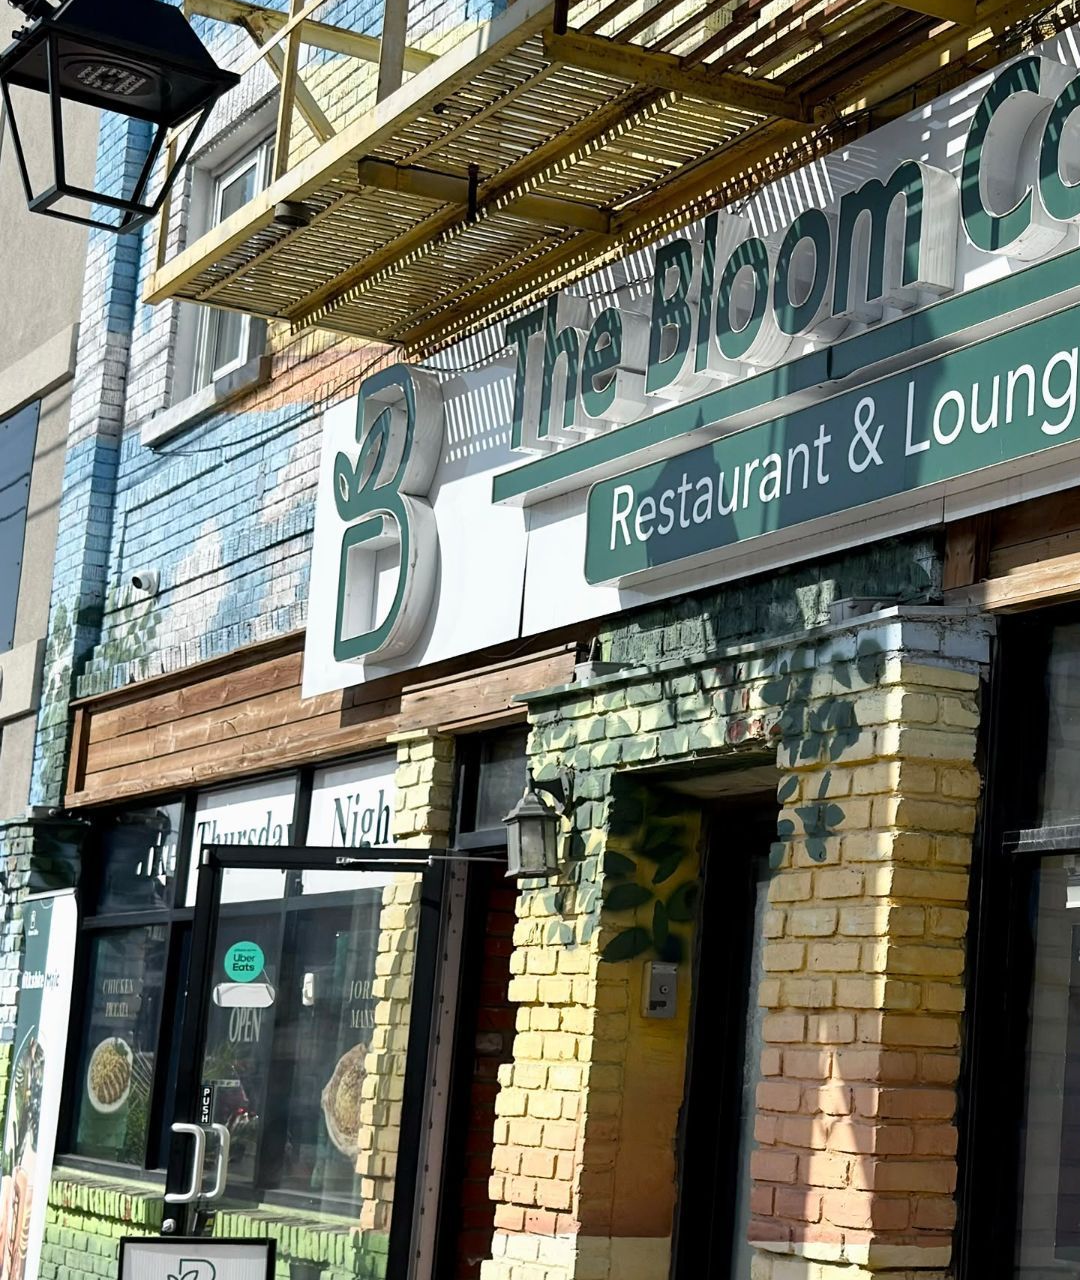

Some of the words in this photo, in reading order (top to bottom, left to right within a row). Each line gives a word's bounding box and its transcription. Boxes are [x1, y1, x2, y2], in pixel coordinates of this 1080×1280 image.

[504, 293, 623, 450] The
[643, 158, 927, 403] Bloom
[609, 427, 832, 552] Restaurant
[848, 396, 885, 473] &
[331, 789, 399, 849] Nigh
[232, 962, 255, 971] Eats
[233, 953, 255, 962] Uber
[229, 1006, 262, 1042] OPEN
[201, 1088, 210, 1122] PUSH
